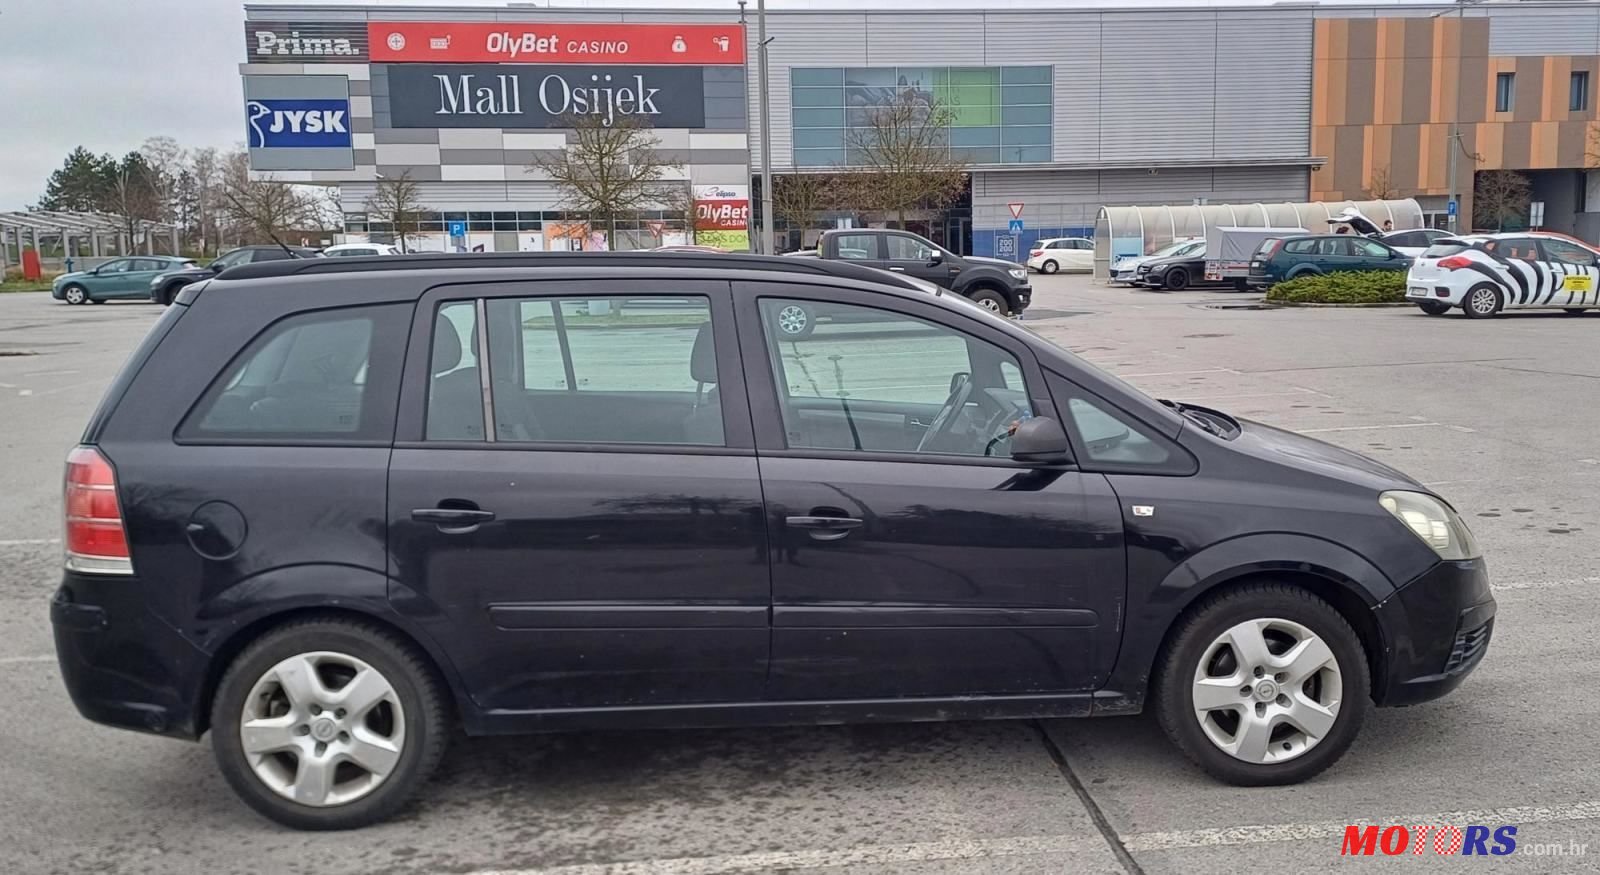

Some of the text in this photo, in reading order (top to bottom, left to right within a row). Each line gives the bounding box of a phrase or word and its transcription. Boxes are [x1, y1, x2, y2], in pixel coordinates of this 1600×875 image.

[255, 31, 360, 55] Prima.
[486, 31, 628, 58] OlyBet CASINO
[433, 74, 662, 127] Mall Osijek
[269, 110, 347, 133] JYSK
[696, 203, 748, 223] OlyBet
